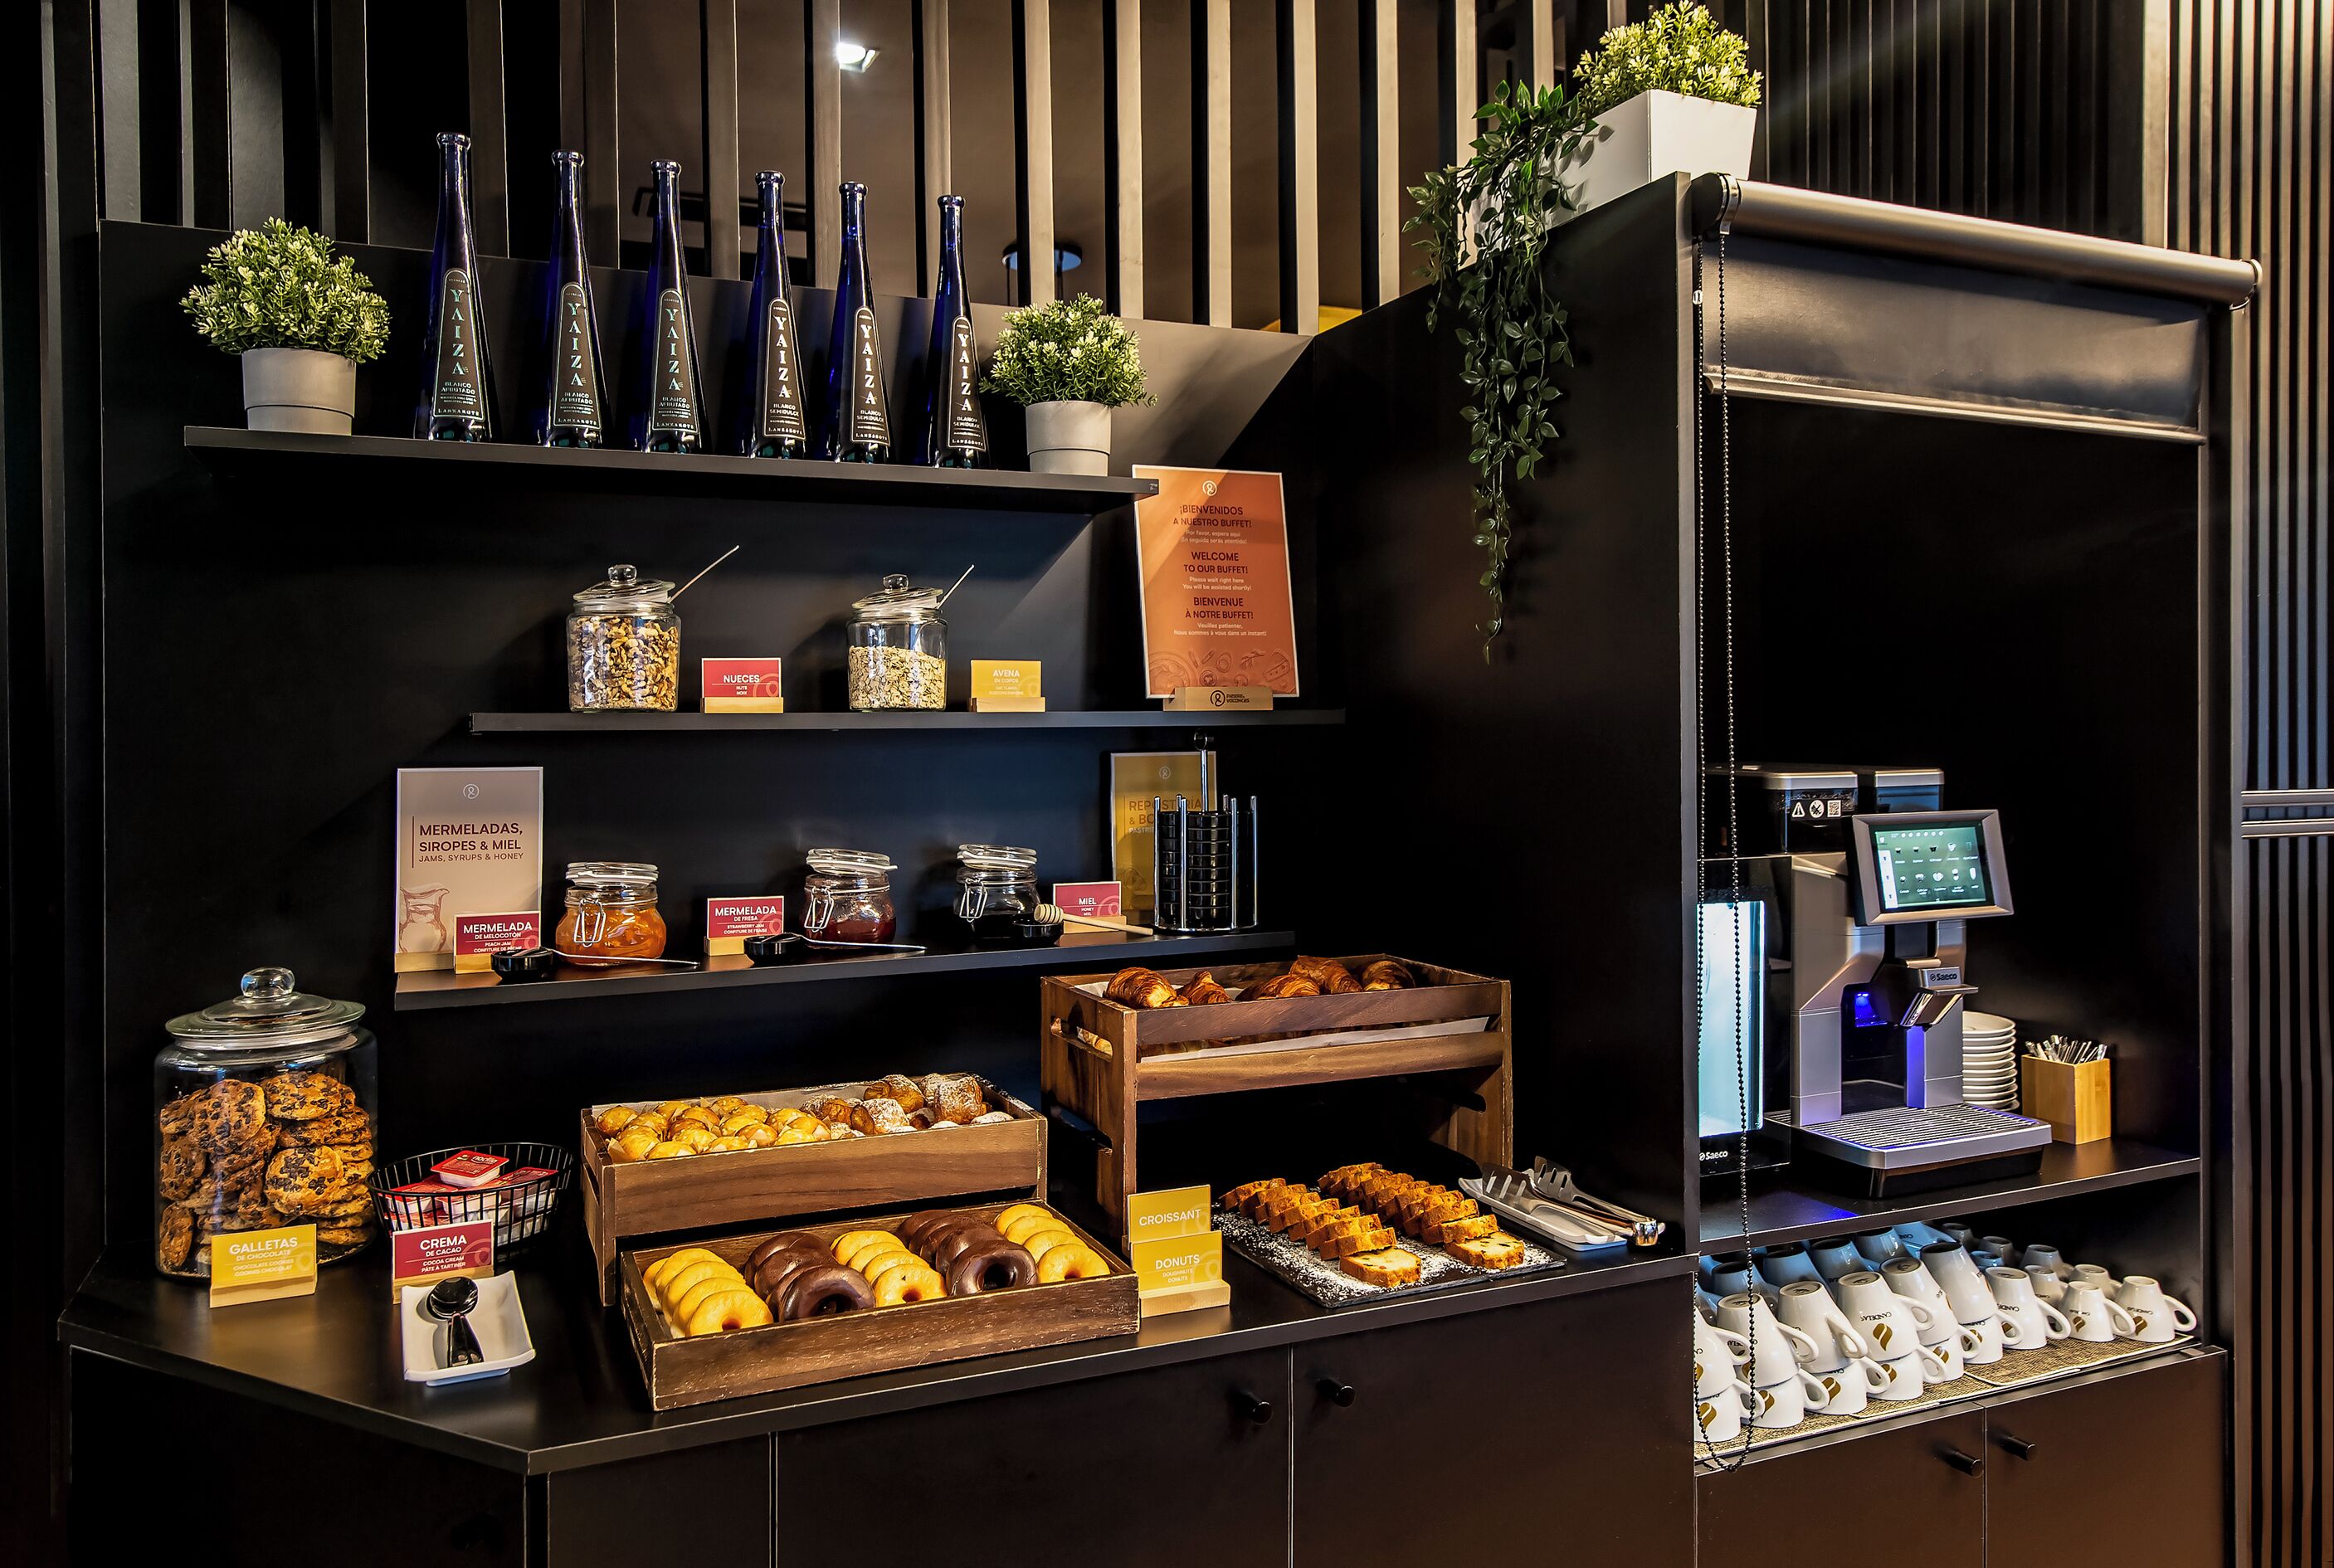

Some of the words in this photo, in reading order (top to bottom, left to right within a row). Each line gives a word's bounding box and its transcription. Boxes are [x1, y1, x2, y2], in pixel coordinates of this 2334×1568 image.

[451, 290, 465, 375] YAIZA
[568, 302, 583, 387] YAIZA
[665, 308, 680, 391] YAIZA
[773, 315, 791, 398] YAIZA
[860, 324, 876, 405] YAIZA
[957, 334, 972, 411] YAIZA
[1179, 504, 1244, 515] ¡BIENVENIDOS
[1182, 518, 1219, 526] NUESTRO
[1221, 519, 1252, 528] BUFFET!
[1191, 551, 1240, 561] WELCOME
[1183, 564, 1196, 572] TO
[1217, 565, 1248, 574] BUFFET!
[1193, 597, 1243, 607] BIENVENUE
[1185, 609, 1191, 617] À
[1193, 611, 1221, 619] NOTRE
[1223, 611, 1254, 619] BUFFET!
[724, 674, 760, 684] NUECES
[420, 823, 523, 836] MERMELADAS,
[419, 840, 476, 852] SIROPES
[480, 841, 489, 850] &
[493, 840, 521, 850] MIEL
[418, 855, 446, 863] JAMS,
[715, 906, 777, 916] MERMELADA
[463, 921, 533, 934] MERMELADA
[1705, 1150, 1729, 1160] Saeco
[1138, 1209, 1201, 1226] CROISSANT
[229, 1237, 299, 1254] GALLETAS
[420, 1234, 467, 1250] CREMA
[247, 1249, 290, 1260] CHOCOLATE
[436, 1246, 461, 1255] CACAO
[233, 1263, 267, 1271] CHOCOLATE
[1155, 1254, 1201, 1269] DONUTS
[1162, 1268, 1193, 1278] DOUGHNUTS
[1860, 1311, 1892, 1322] CANDELAS
